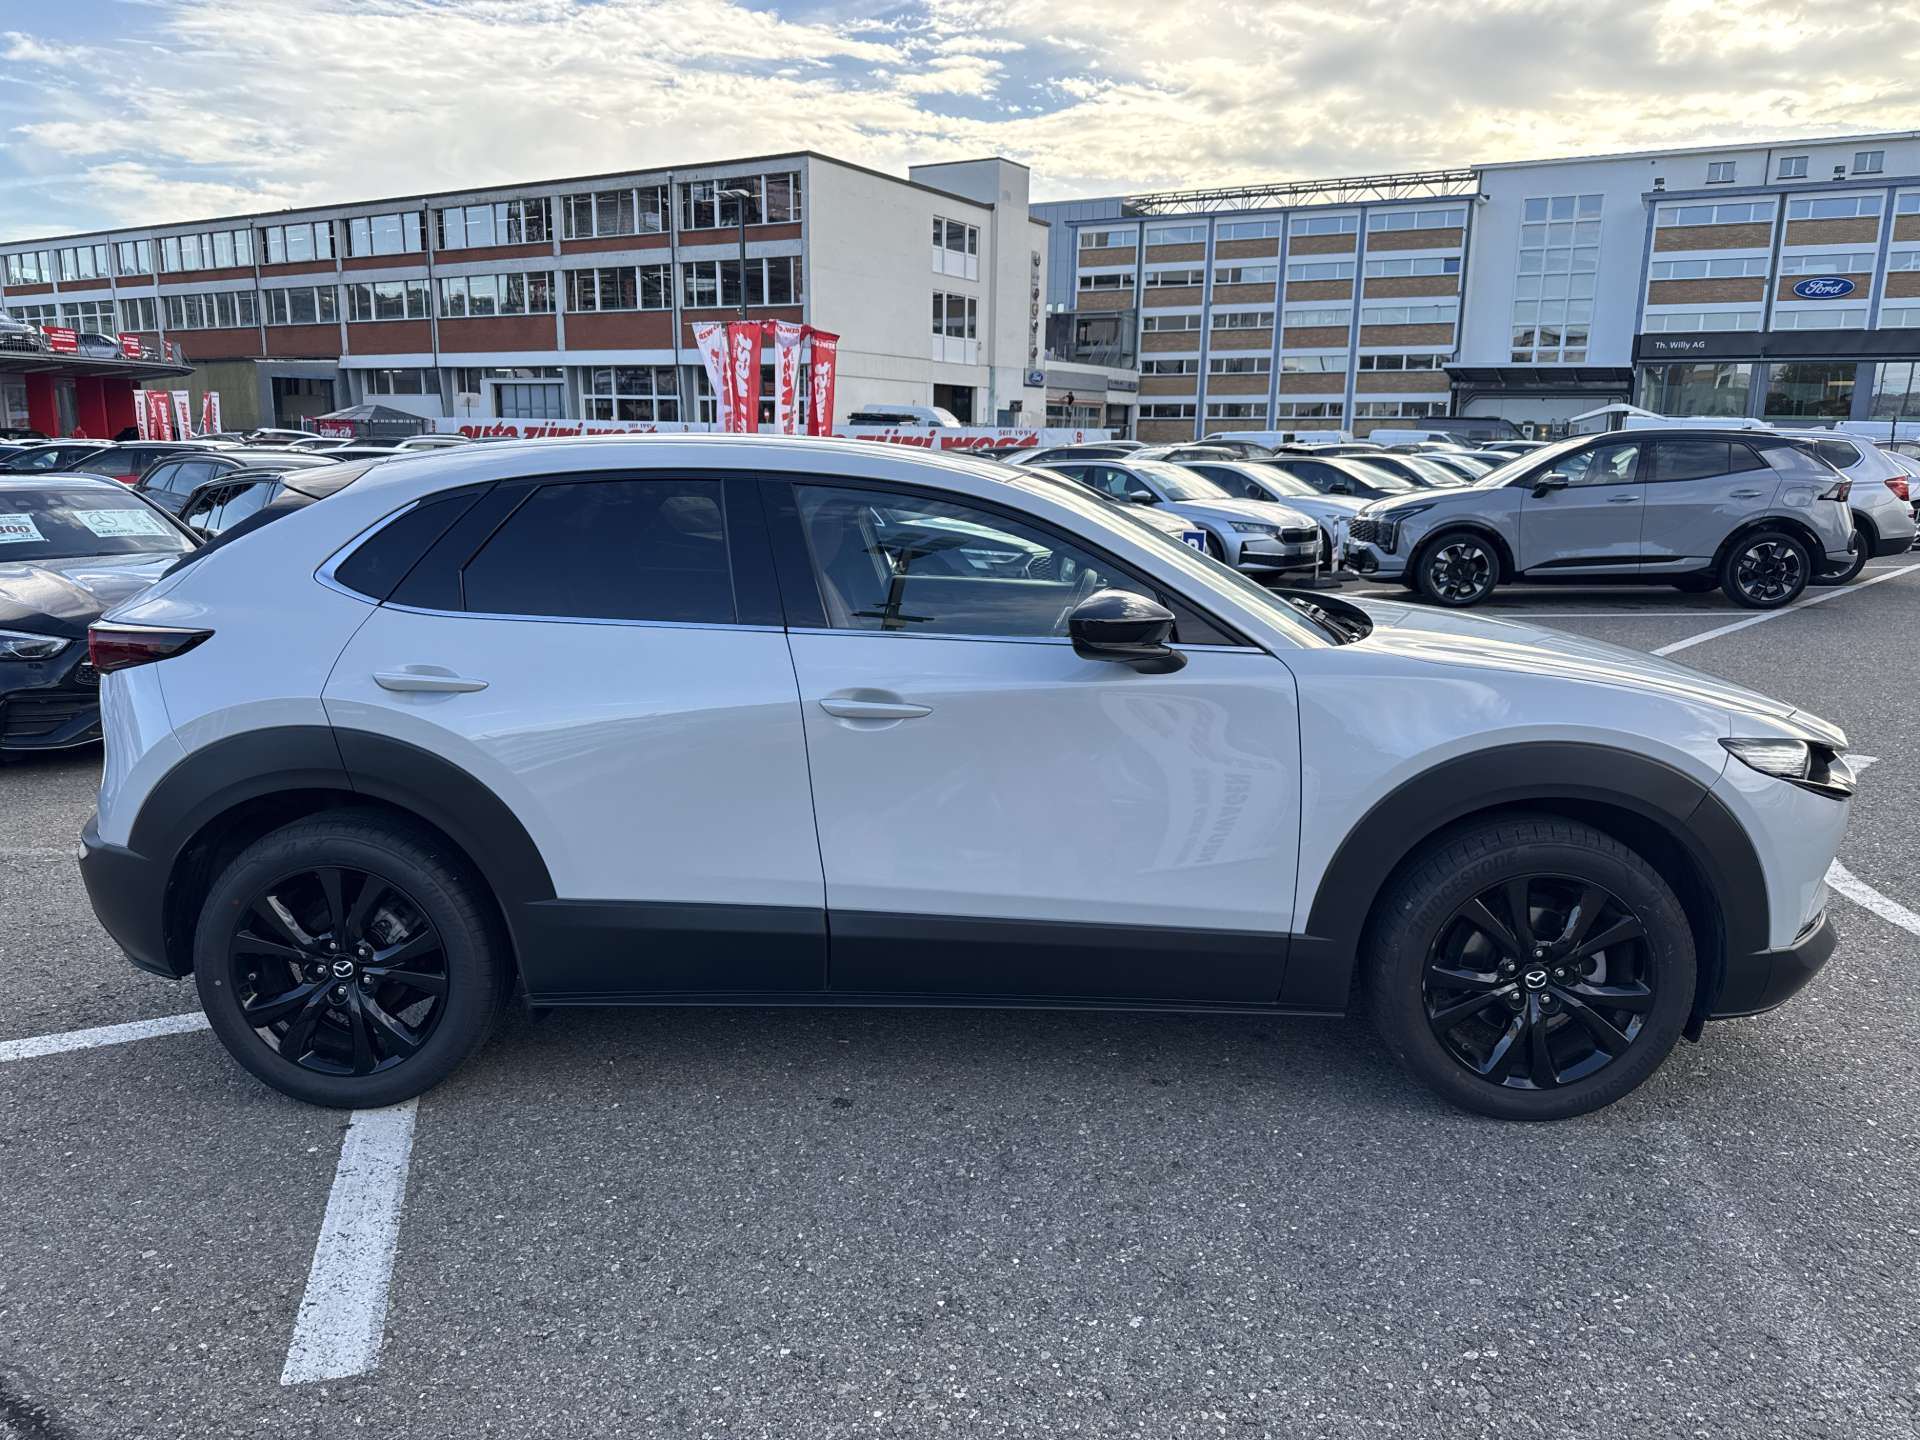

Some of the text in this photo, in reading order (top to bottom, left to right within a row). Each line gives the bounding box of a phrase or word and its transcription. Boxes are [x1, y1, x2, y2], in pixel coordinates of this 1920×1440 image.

[1804, 279, 1843, 295] Ford
[1670, 341, 1691, 351] Willy
[1692, 340, 1706, 349] AG
